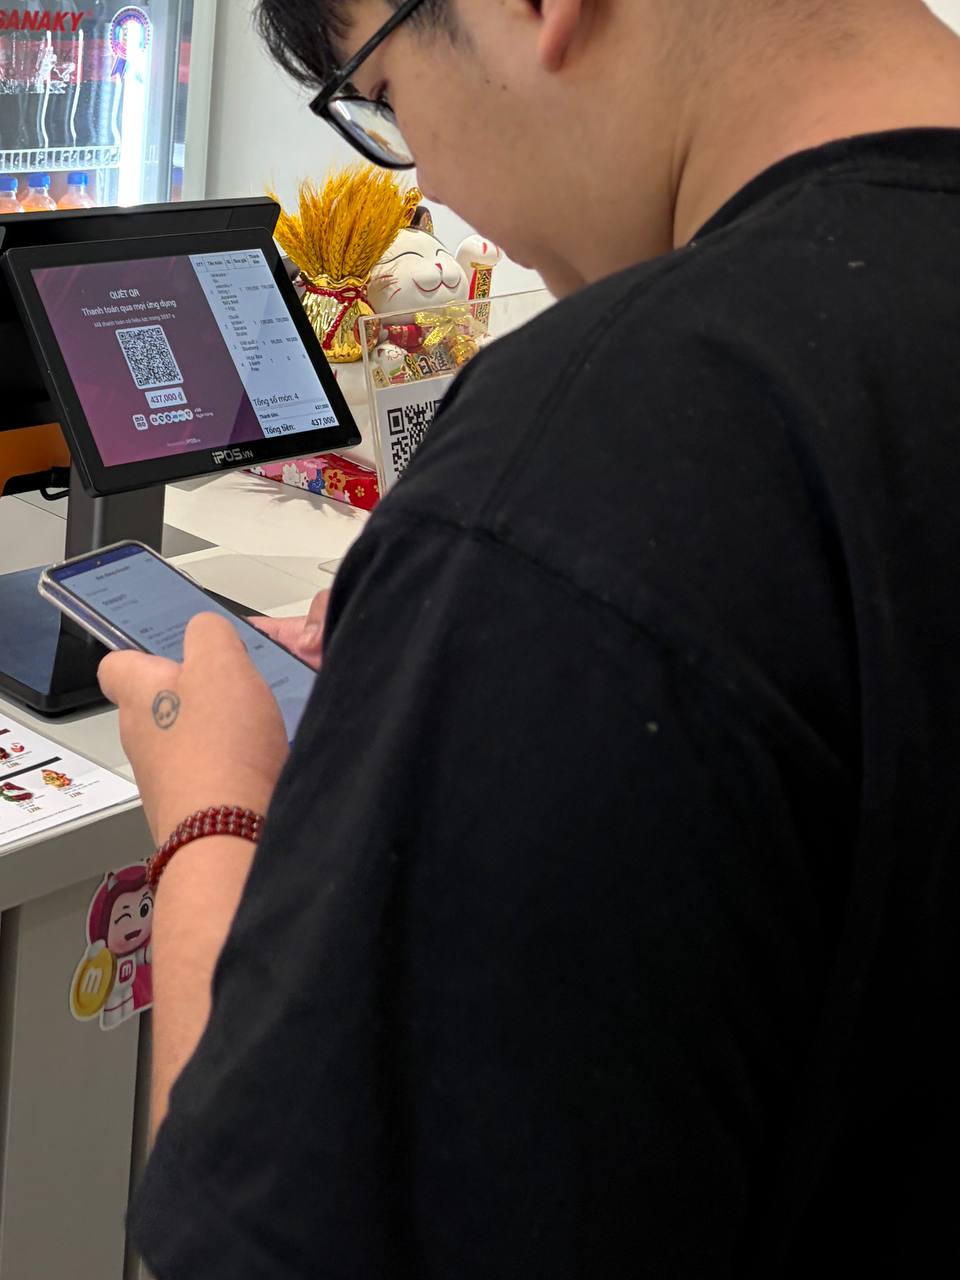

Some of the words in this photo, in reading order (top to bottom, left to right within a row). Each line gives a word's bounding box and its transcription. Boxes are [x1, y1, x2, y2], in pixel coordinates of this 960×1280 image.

[129, 288, 141, 298] QR
[82, 306, 104, 317] Thanh
[104, 304, 120, 314] toán
[121, 304, 133, 315] qua
[133, 302, 147, 312] mọi
[147, 300, 160, 312] ứng
[160, 299, 177, 309] dụng
[150, 393, 177, 404] 437,000
[253, 397, 270, 407] Tổng
[271, 395, 279, 404] số
[265, 425, 281, 435] Tổng
[282, 422, 296, 433] tiền:
[311, 416, 336, 427] 437,000
